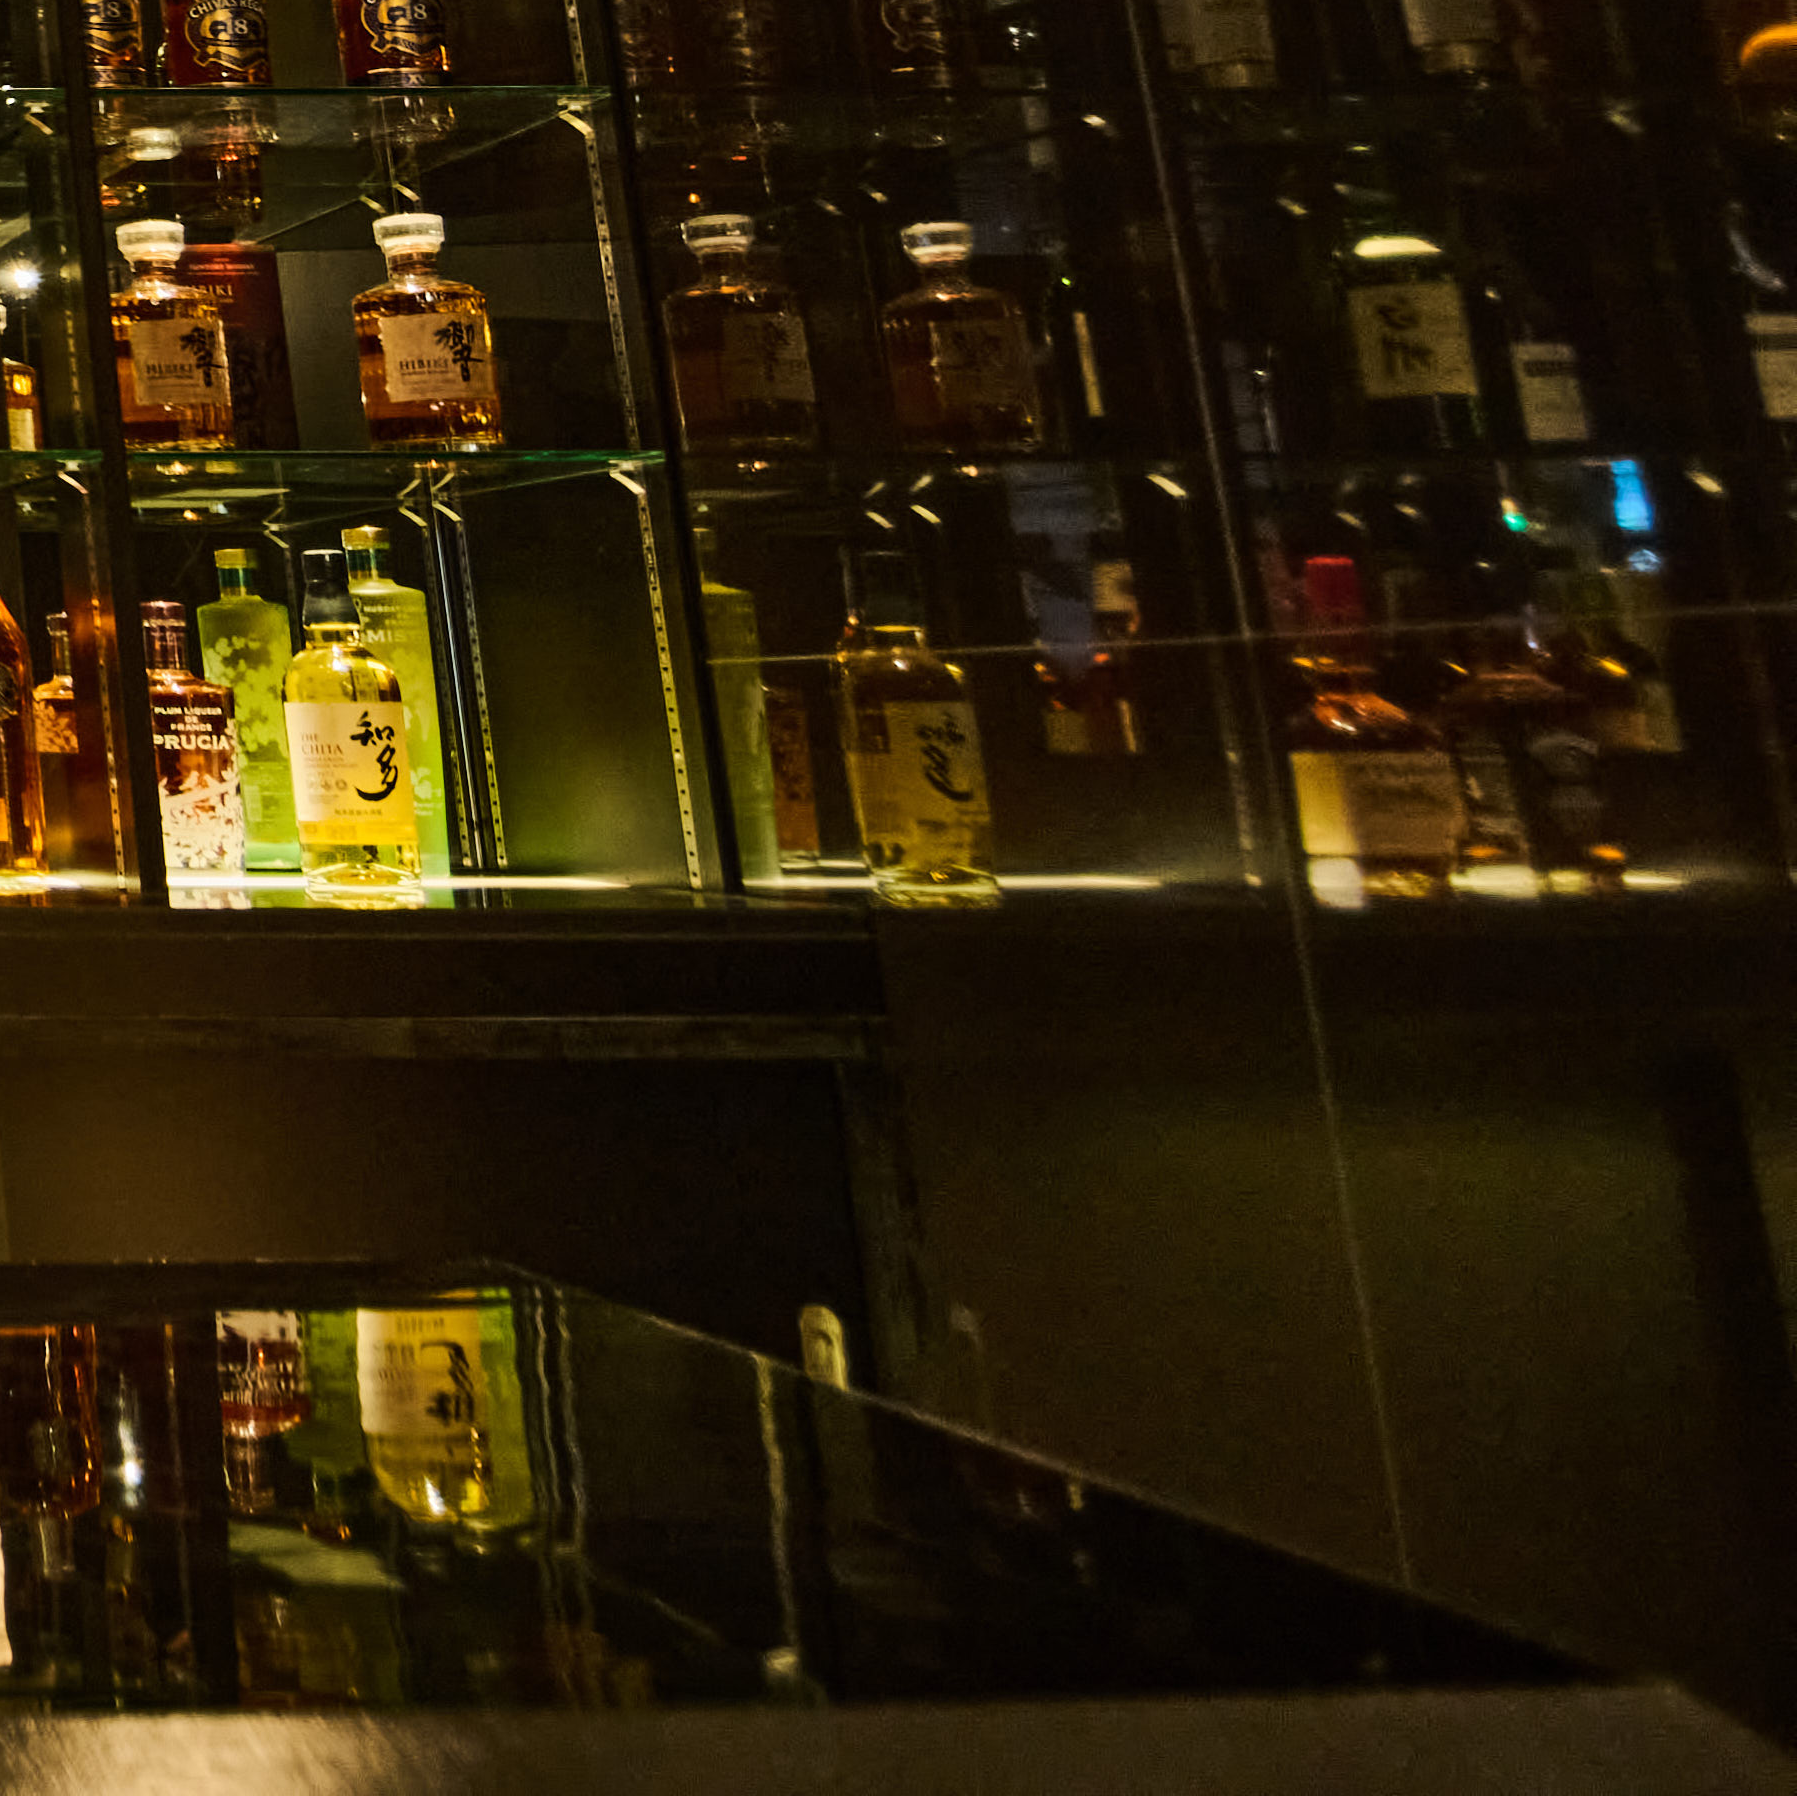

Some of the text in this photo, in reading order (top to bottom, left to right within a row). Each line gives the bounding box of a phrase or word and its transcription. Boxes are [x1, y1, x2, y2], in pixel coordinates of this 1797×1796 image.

[404, 3, 428, 21] 18
[226, 18, 249, 35] 18
[432, 320, 485, 382] 響
[152, 734, 230, 751] PRUCIA
[301, 744, 344, 756] CHITA
[350, 710, 399, 801] 知多
